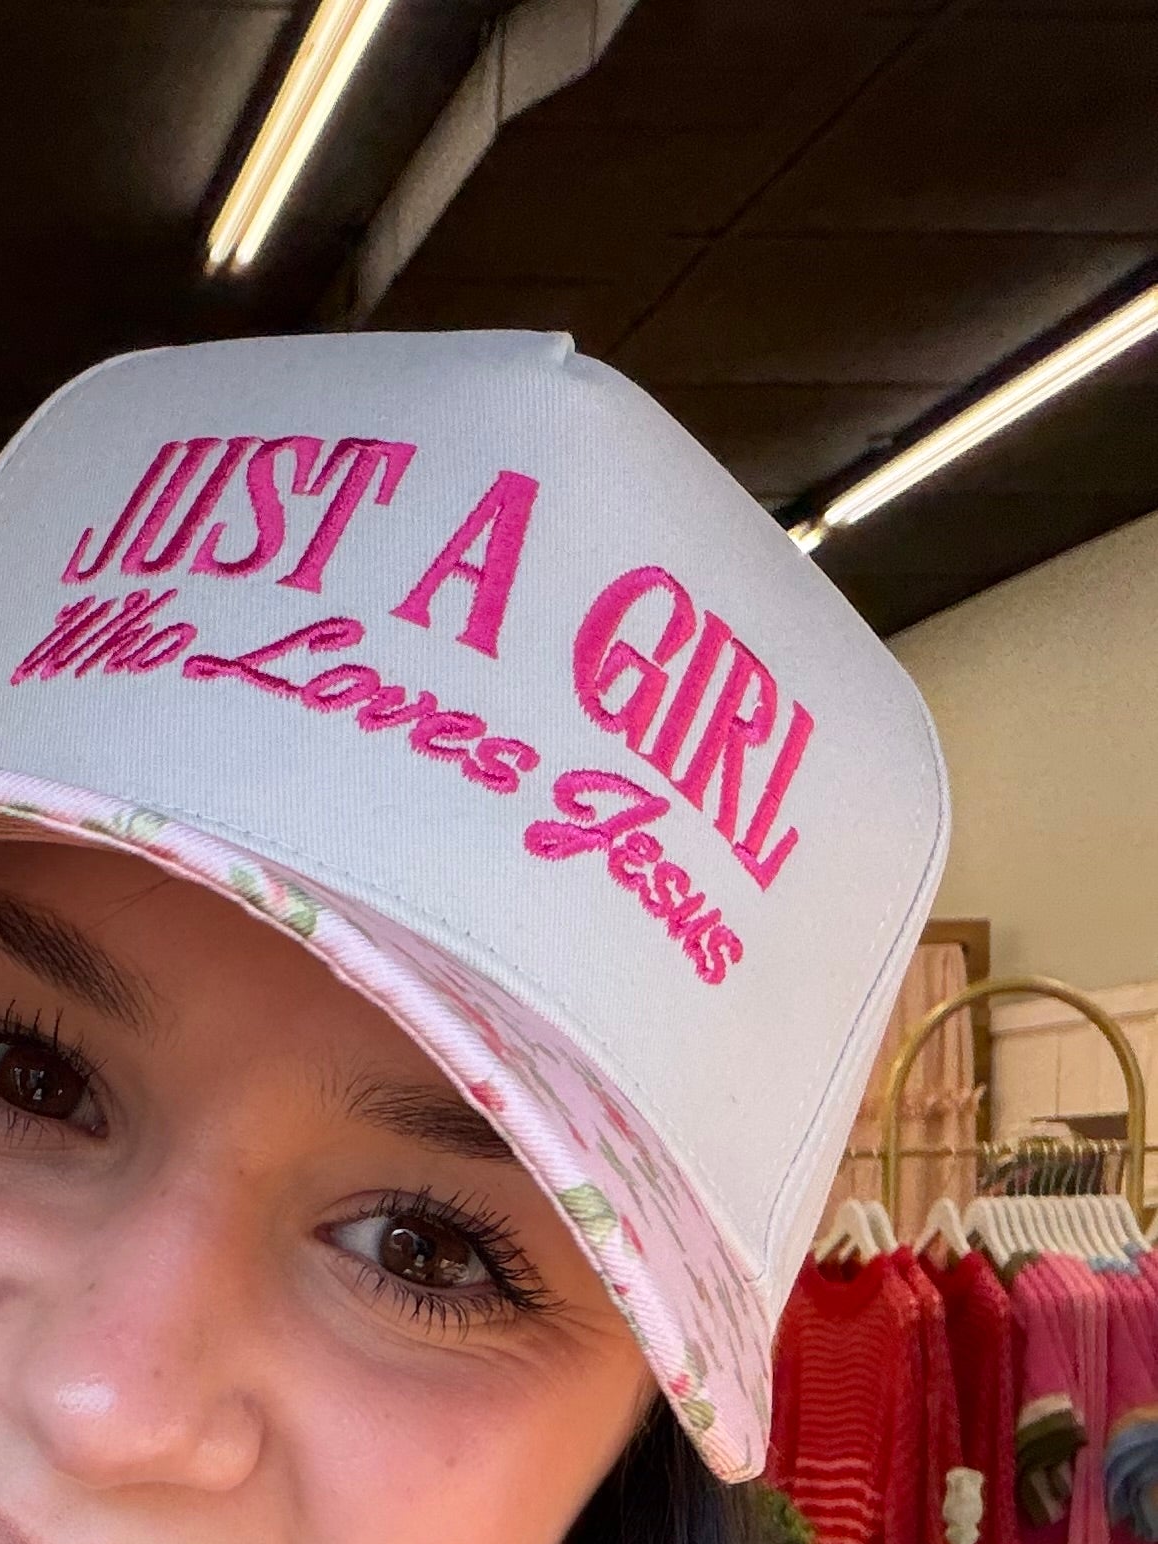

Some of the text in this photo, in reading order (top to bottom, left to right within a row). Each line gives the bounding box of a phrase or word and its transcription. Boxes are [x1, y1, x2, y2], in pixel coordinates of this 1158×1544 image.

[10, 587, 744, 986] Who Loves Jesus
[61, 435, 815, 892] JUST A GIRL
